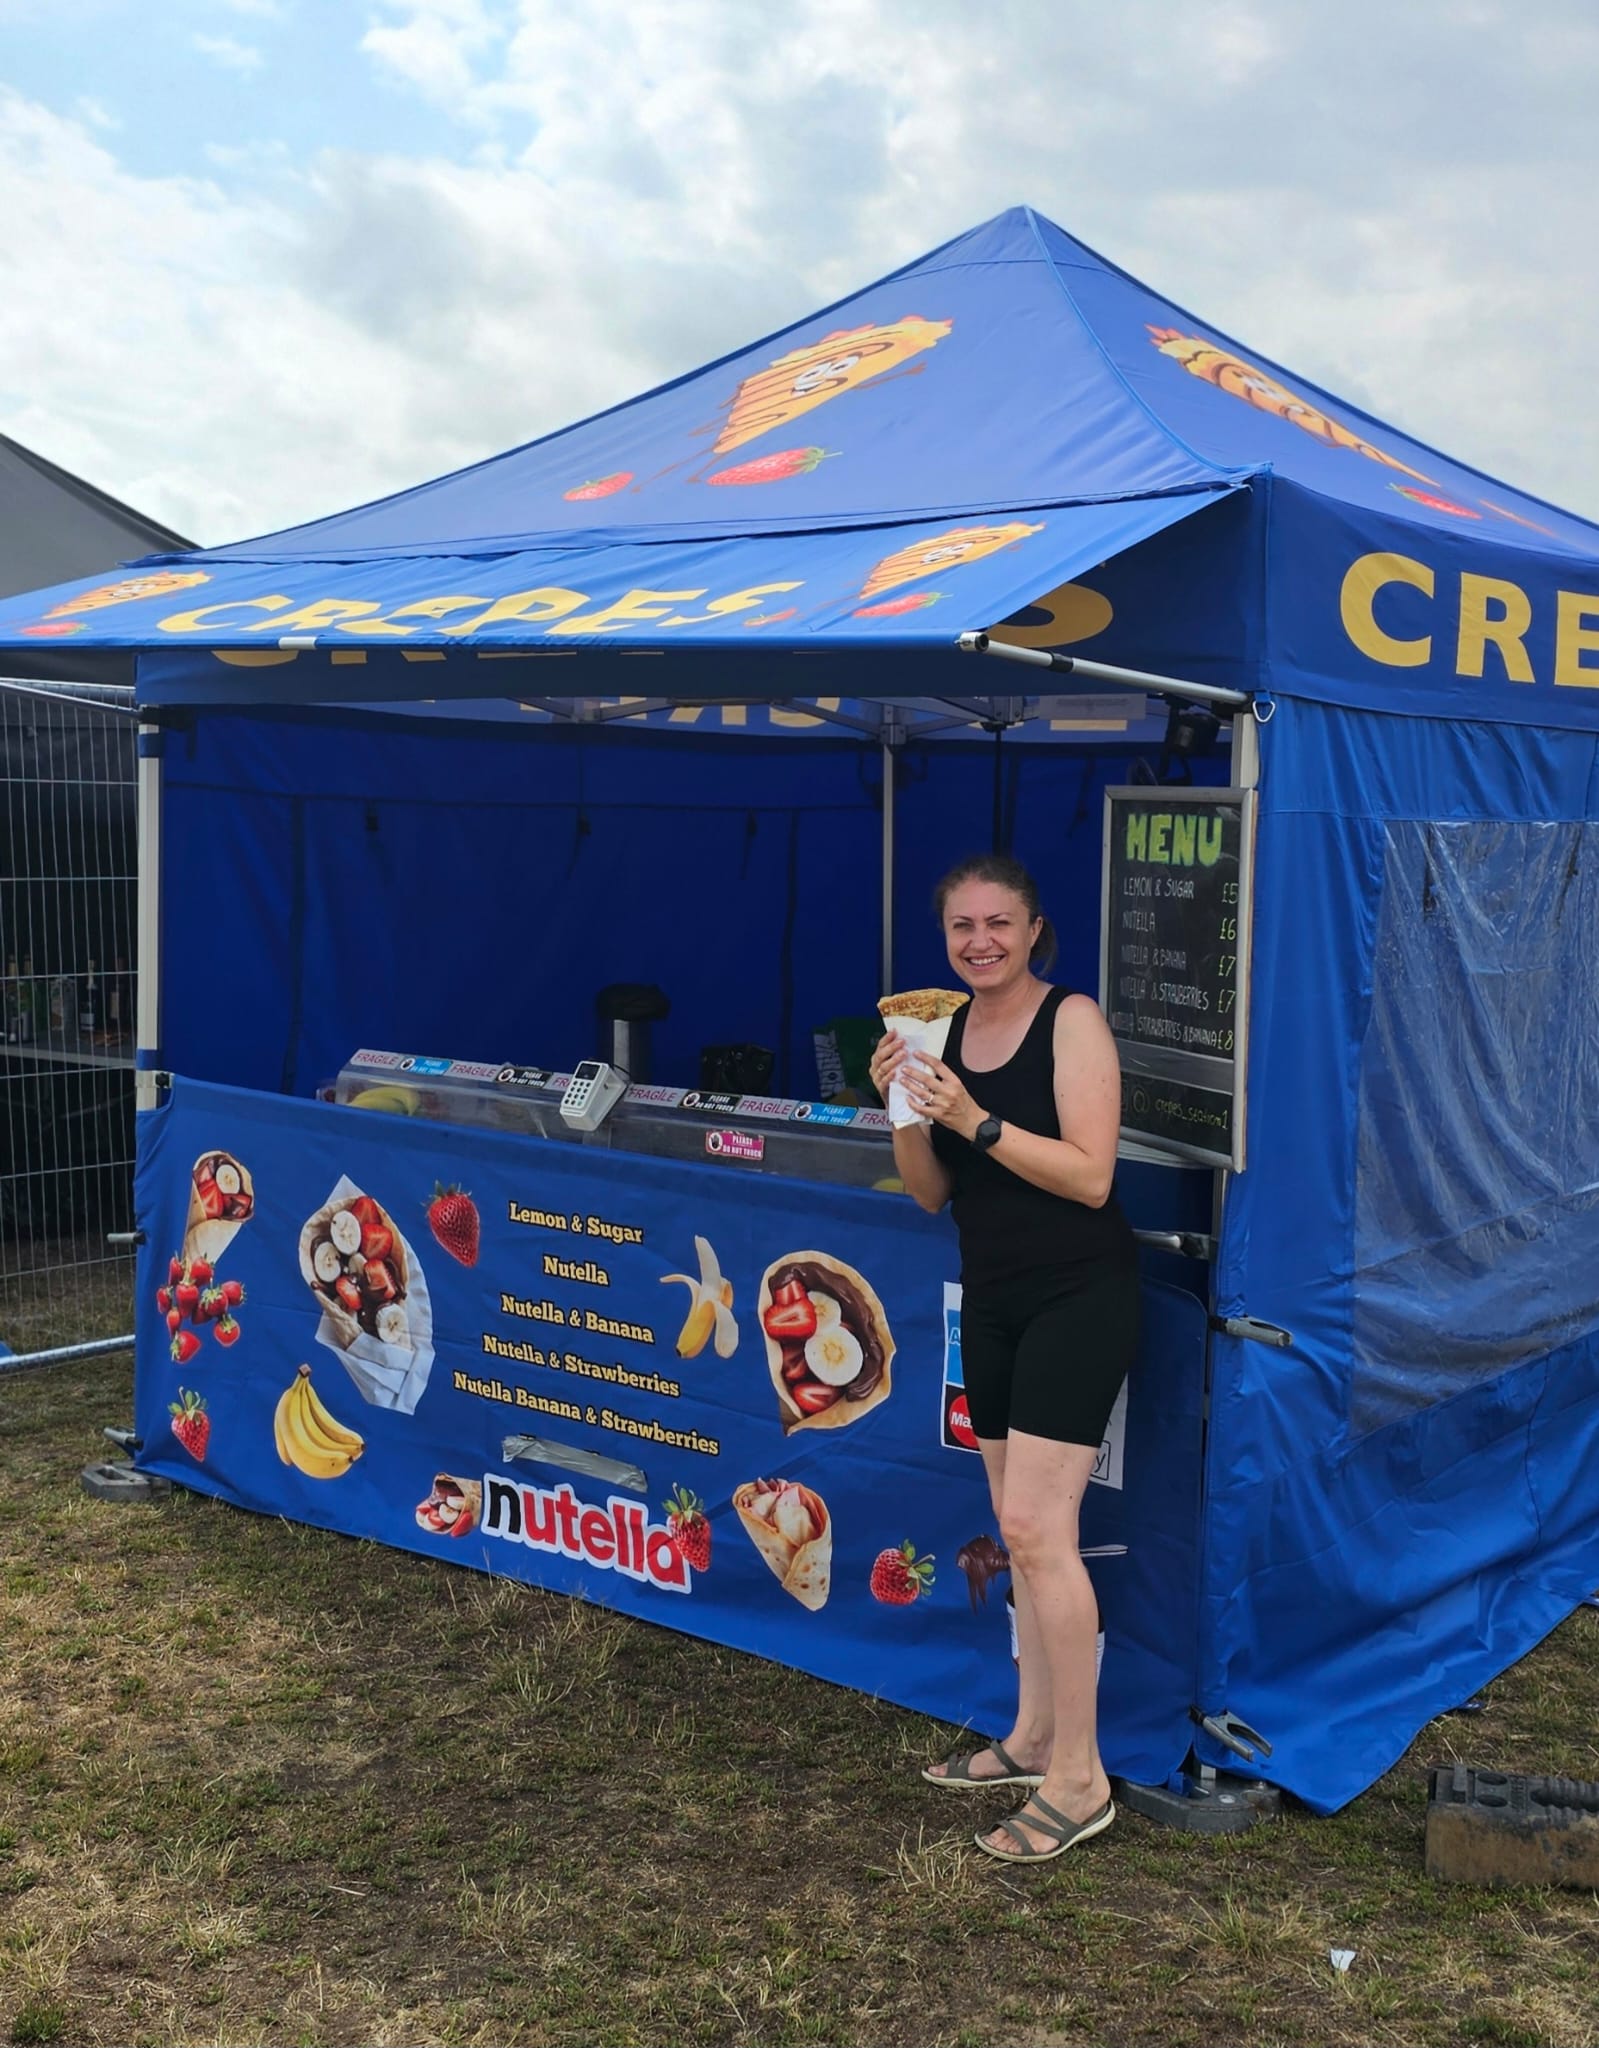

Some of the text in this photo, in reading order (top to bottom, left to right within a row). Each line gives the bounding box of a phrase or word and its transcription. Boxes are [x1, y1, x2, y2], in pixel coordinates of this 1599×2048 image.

[156, 581, 805, 635] CREPES
[1126, 813, 1223, 867] MENU
[1123, 876, 1239, 904] LEMON & SUGAR £5
[1219, 917, 1236, 940] £6
[1218, 954, 1237, 977] £7
[1217, 988, 1236, 1013] £7
[354, 1052, 399, 1066] FRAGILE
[451, 1063, 496, 1078] FRAGILE
[628, 1086, 677, 1104] FRAGILE
[739, 1100, 793, 1116] FRAGILE
[722, 1145, 762, 1158] DO NOT TOUCH
[733, 1135, 753, 1146] PLEASE
[508, 1201, 643, 1245] Lemon & Sugar
[543, 1255, 610, 1286] Nutella
[501, 1293, 654, 1343] Nutella & Banana
[483, 1333, 681, 1397] Nutella & Strawberries
[453, 1371, 720, 1456] Nutella Banana & Strawberries
[486, 1479, 687, 1587] nutella
